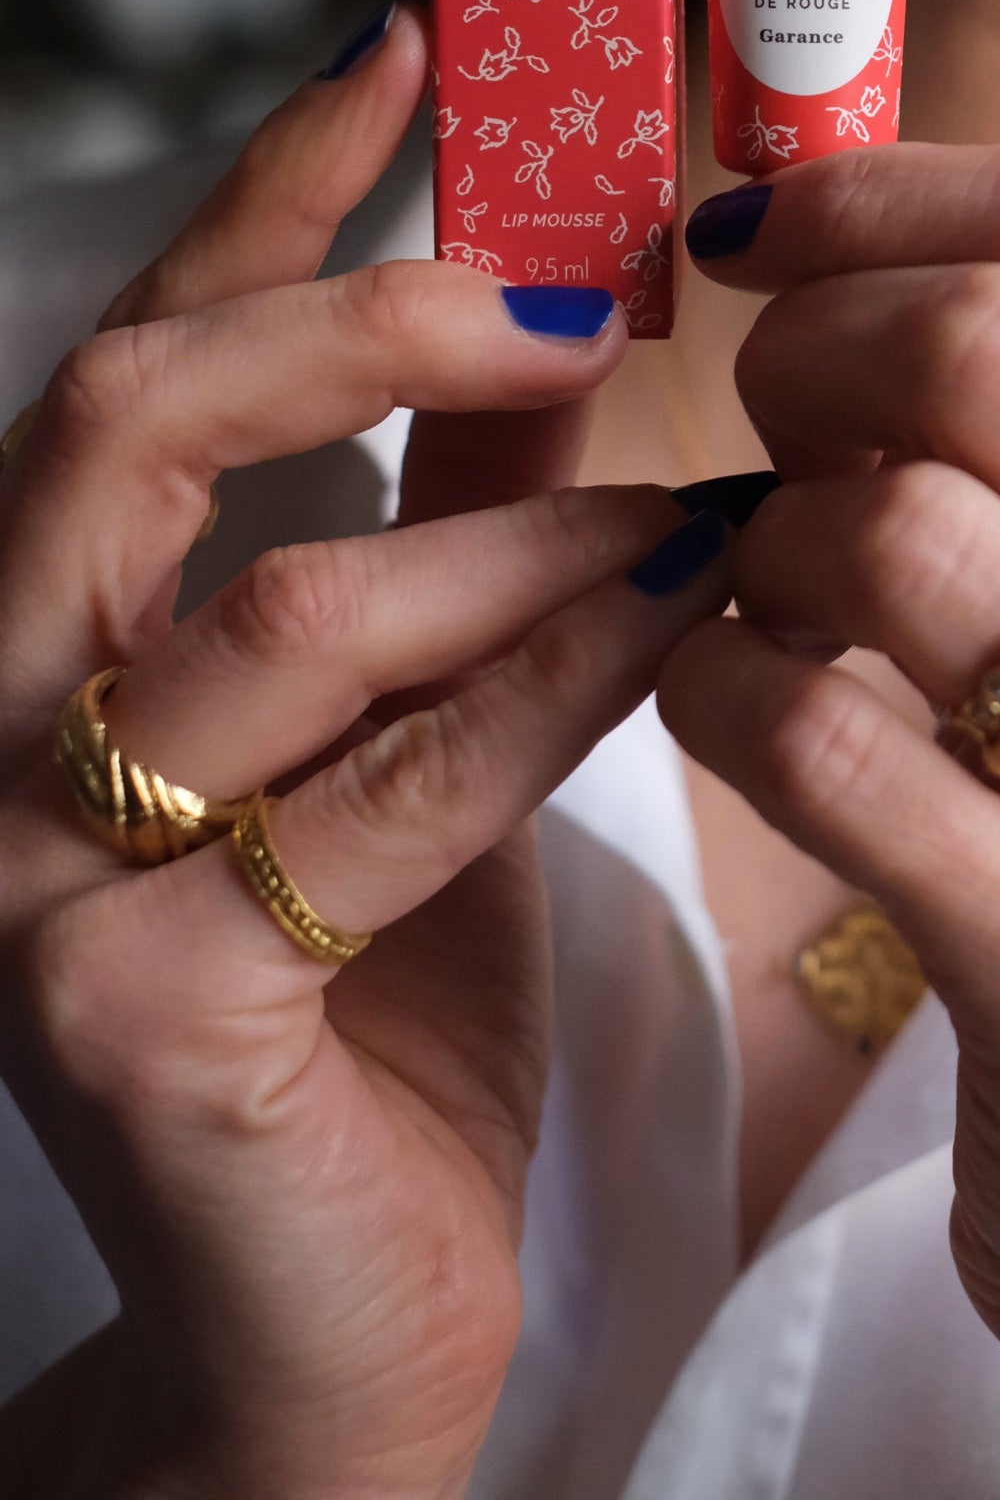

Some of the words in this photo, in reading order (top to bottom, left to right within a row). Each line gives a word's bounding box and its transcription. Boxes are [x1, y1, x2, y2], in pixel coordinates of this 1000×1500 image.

[759, 28, 844, 45] Garance
[501, 213, 529, 228] LIP
[532, 213, 605, 228] MOUSSE
[525, 256, 558, 285] 9,5
[564, 255, 589, 281] ml
